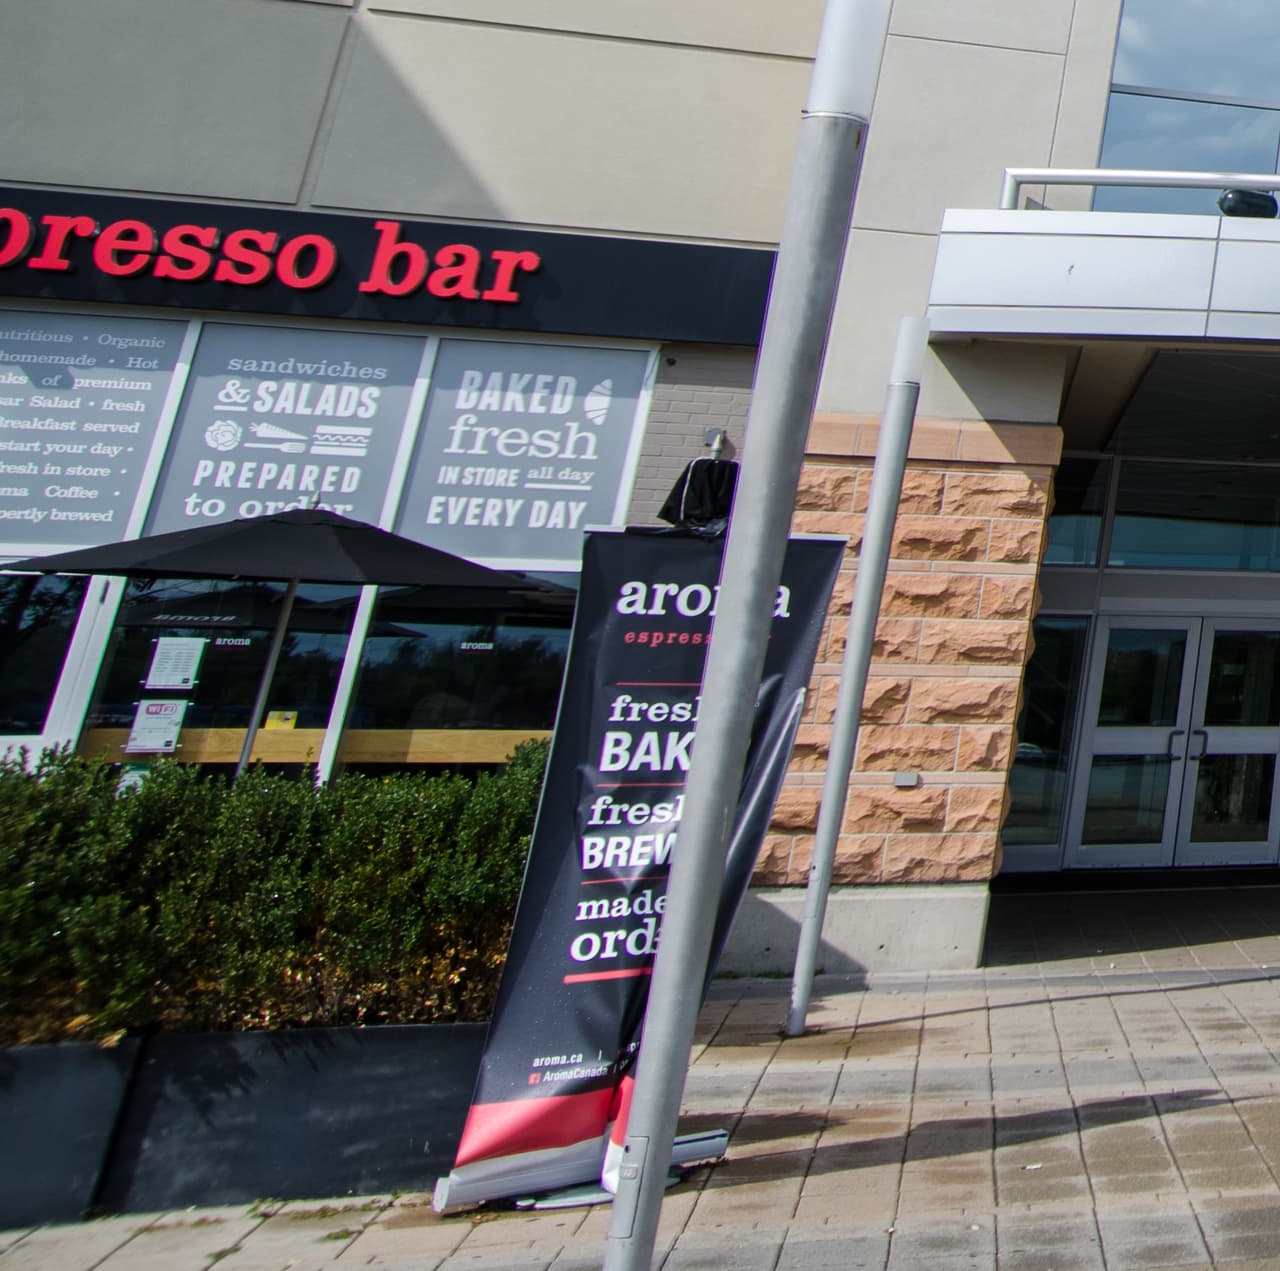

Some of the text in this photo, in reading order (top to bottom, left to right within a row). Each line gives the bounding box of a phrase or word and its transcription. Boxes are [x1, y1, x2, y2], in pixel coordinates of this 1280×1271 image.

[358, 221, 543, 303] bar
[97, 334, 166, 349] Organic
[0, 350, 160, 370] homemade Hot
[227, 358, 388, 379] sandwiches
[42, 375, 62, 386] of
[72, 378, 152, 390] premium
[455, 370, 577, 415] BAKED
[29, 395, 81, 409] Salad
[101, 399, 146, 412] fresh
[217, 379, 381, 419] & SALADS
[82, 422, 141, 434] served
[443, 414, 599, 460] fresh
[0, 440, 123, 457] start your day
[42, 462, 62, 475] in
[65, 465, 111, 477] store
[192, 460, 362, 493] PREPARED
[437, 465, 596, 487] IN STORE all day
[45, 485, 99, 499] Coffee
[185, 492, 354, 518] to ordr
[426, 496, 588, 530] EVERY DAY
[50, 508, 114, 523] brewed
[615, 581, 791, 618] aroa
[215, 637, 251, 646] aroma
[570, 917, 662, 962] ord
[532, 1053, 584, 1068] aroma.ca
[543, 1065, 609, 1082] AromaCanada
